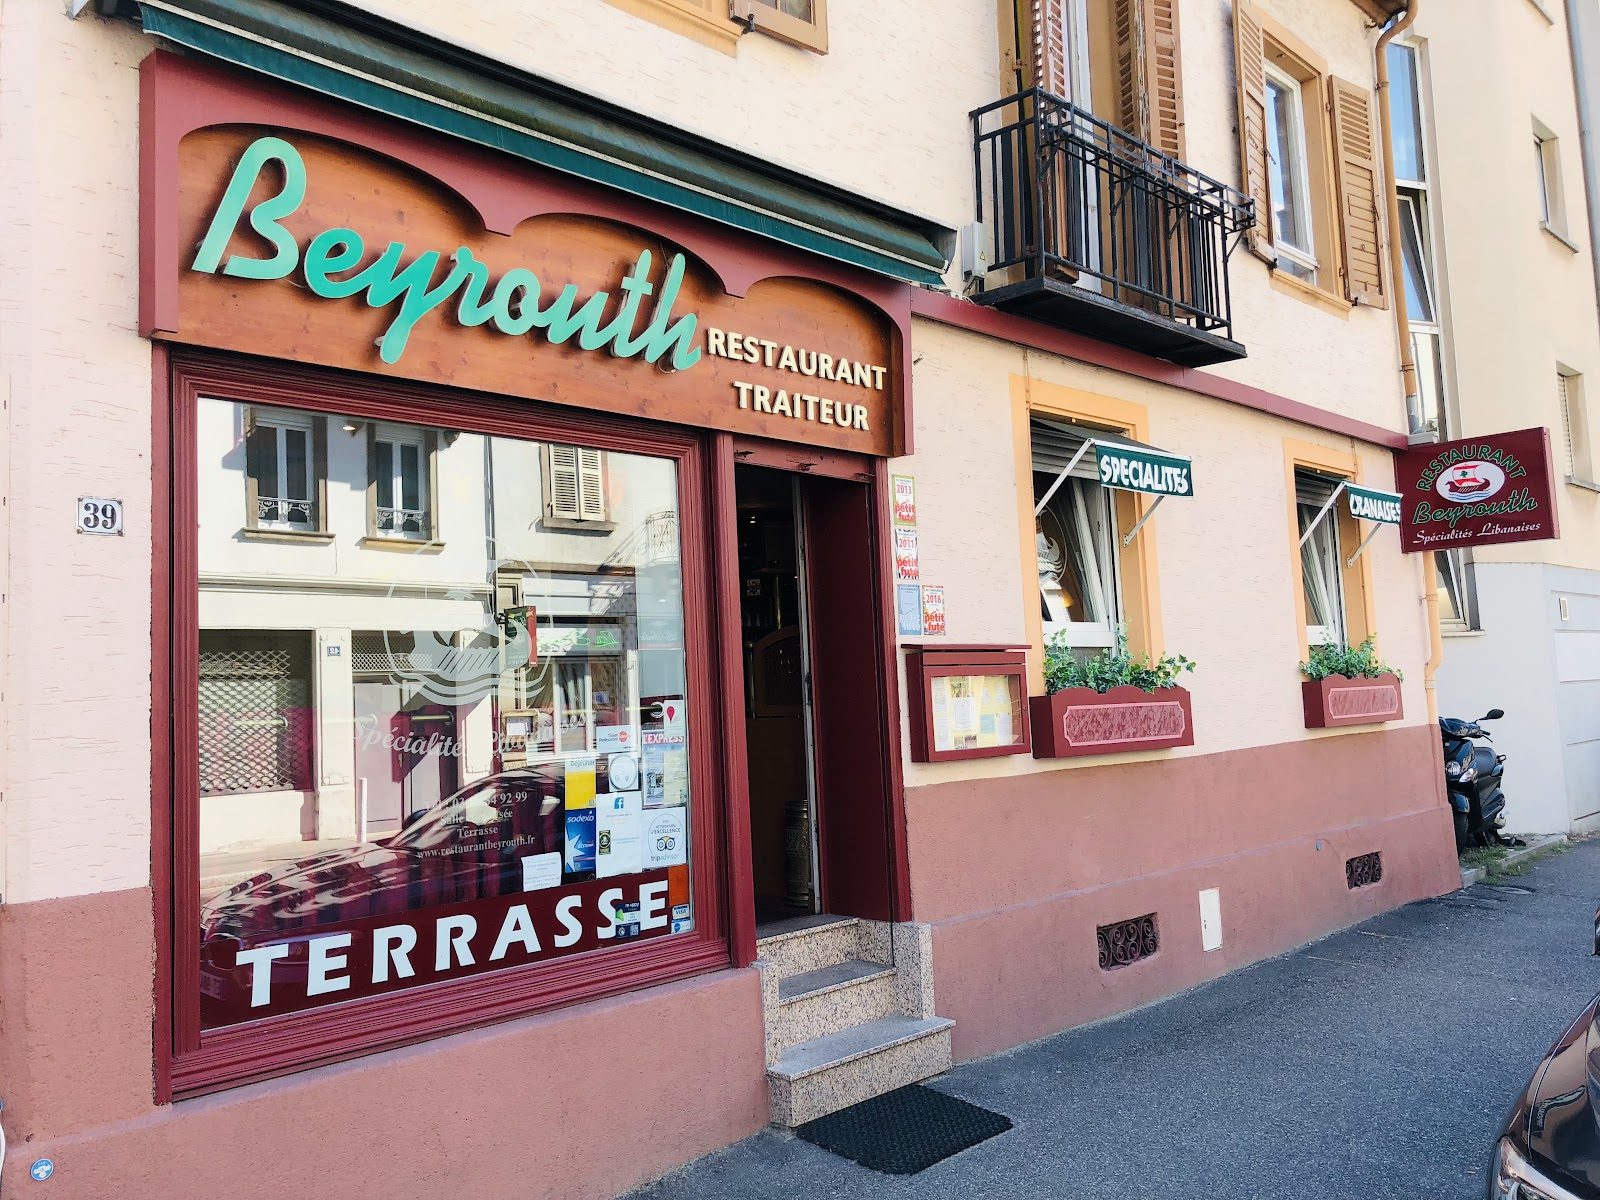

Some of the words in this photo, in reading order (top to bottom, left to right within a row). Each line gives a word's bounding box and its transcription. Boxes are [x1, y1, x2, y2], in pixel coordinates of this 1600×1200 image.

[191, 136, 702, 372] Beyrouth
[707, 326, 888, 391] RESTAURANT
[733, 380, 871, 432] TRAITEUR
[1416, 444, 1527, 492] RESTAURANT
[896, 484, 912, 494] 2013
[83, 502, 117, 530] 39
[1412, 487, 1538, 528] Beyrouth
[1412, 529, 1473, 545] Spécialités
[1476, 522, 1541, 537] Libanaises
[500, 791, 512, 804] 92
[515, 790, 528, 803] 99
[457, 825, 499, 838] Terrasse
[566, 813, 594, 824] sodexo
[417, 835, 536, 859] www.restaurantbeyrouth.fr
[236, 879, 669, 1008] TERRASSE
